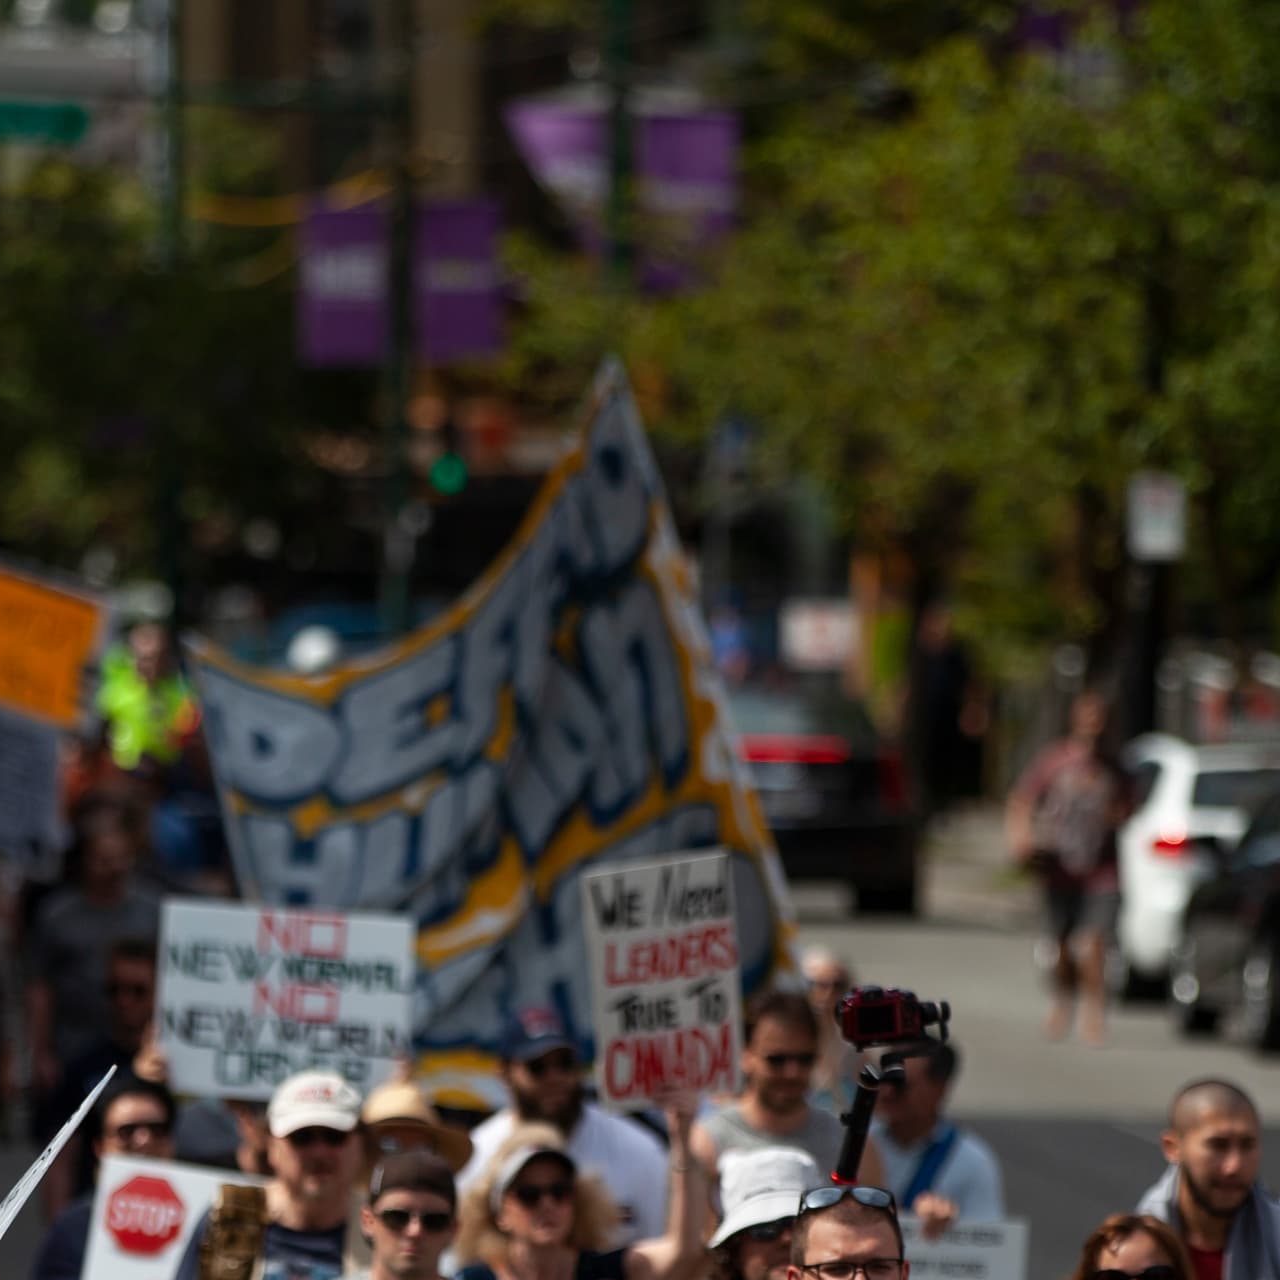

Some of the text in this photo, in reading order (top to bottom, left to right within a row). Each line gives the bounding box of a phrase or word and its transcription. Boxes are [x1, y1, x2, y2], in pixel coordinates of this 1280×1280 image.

[257, 908, 350, 960] NO
[605, 918, 739, 988] LEADERS
[167, 942, 272, 984] NEW
[252, 977, 341, 1024] NO
[163, 1005, 268, 1050] NEW
[604, 1021, 738, 1099] CANADA
[110, 1195, 183, 1237] STOP
